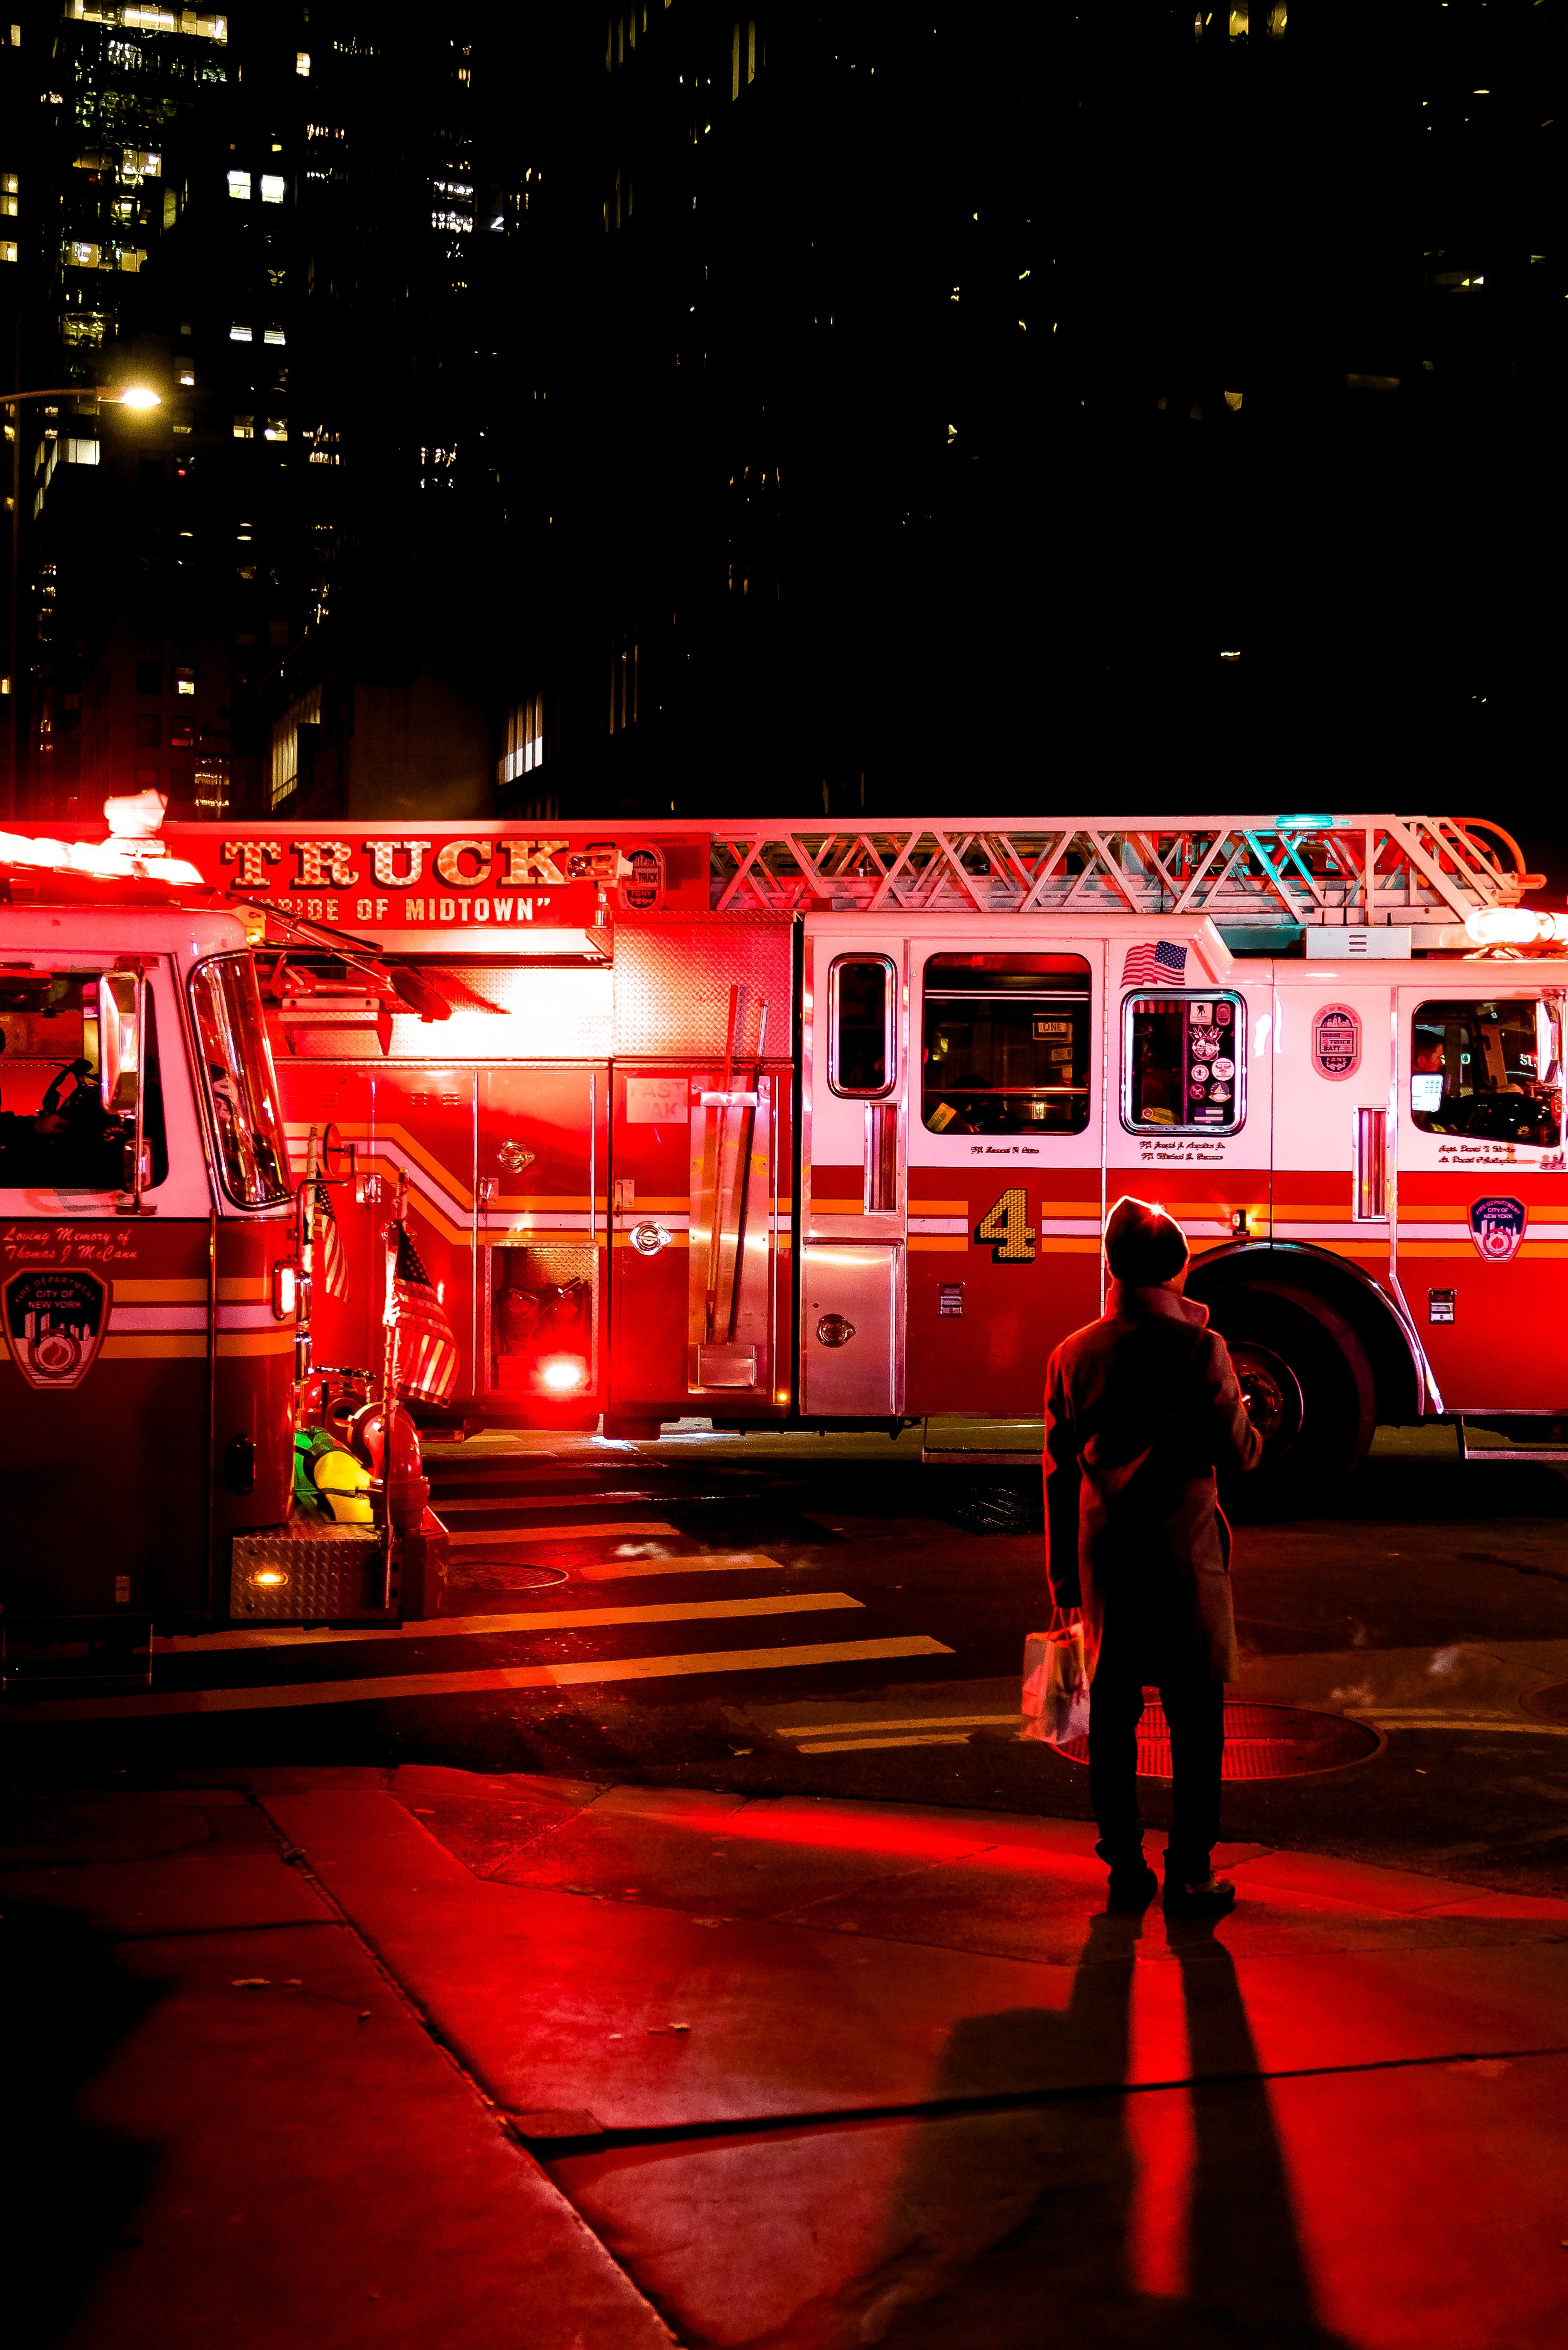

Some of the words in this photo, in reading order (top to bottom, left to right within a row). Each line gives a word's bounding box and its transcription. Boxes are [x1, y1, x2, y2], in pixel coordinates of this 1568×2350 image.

[220, 840, 570, 890] TRUCK
[357, 898, 388, 921] OF
[1043, 1023, 1063, 1032] ONE
[55, 1227, 111, 1245] Memory
[117, 1228, 132, 1245] of
[974, 1188, 1036, 1264] 4
[15, 1285, 32, 1303] FIRE
[34, 1276, 96, 1302] DEPARTMENT
